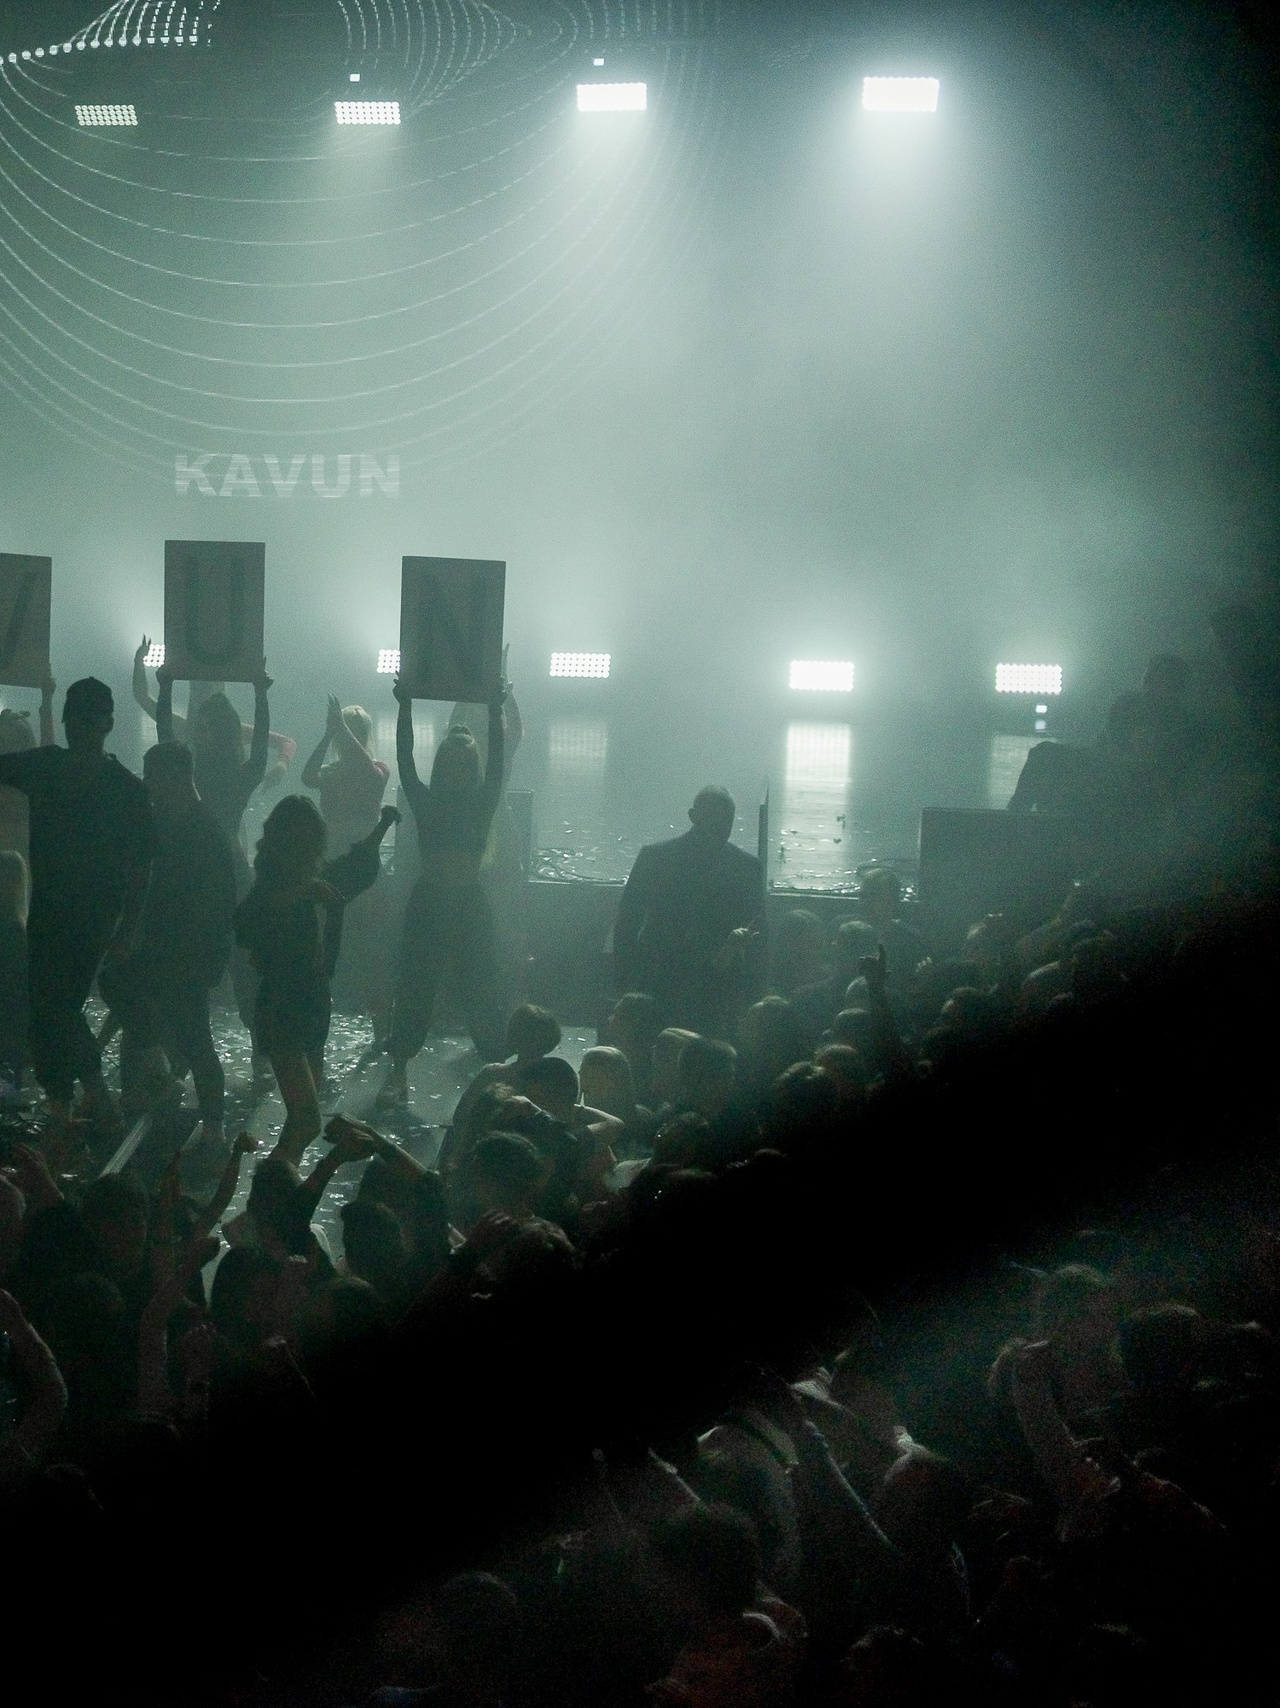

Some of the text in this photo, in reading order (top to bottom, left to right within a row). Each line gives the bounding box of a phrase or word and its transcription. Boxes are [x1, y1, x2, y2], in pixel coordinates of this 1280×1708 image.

[174, 453, 400, 498] KAVUN
[184, 556, 246, 667] U
[417, 572, 487, 687] N
